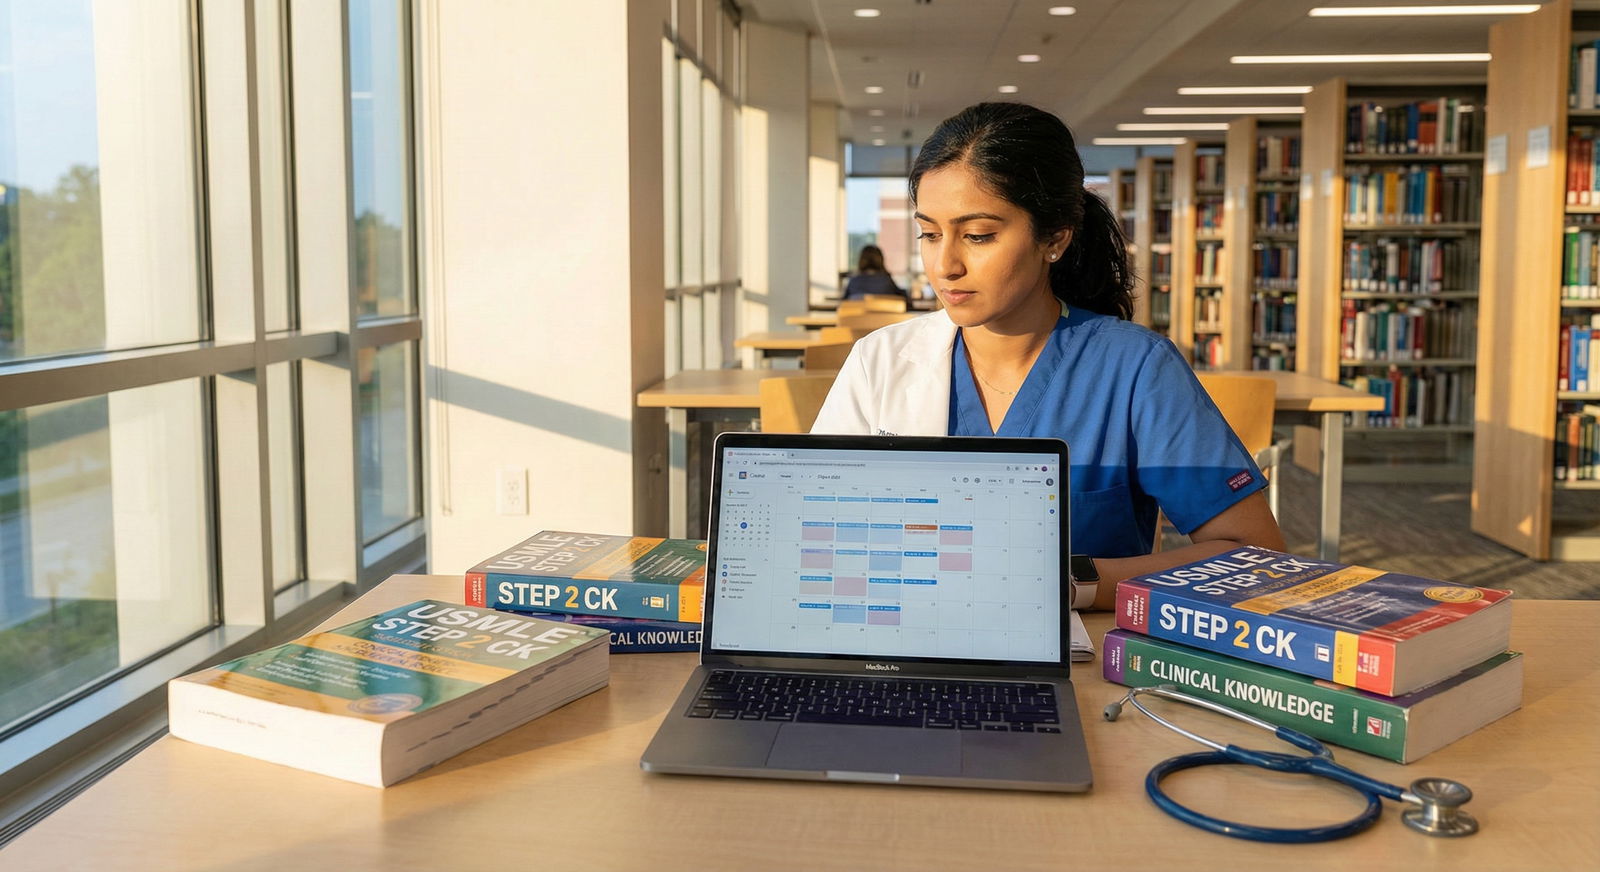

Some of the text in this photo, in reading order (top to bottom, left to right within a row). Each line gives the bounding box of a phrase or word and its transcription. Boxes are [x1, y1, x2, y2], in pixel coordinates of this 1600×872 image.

[486, 534, 575, 570] USMLE
[530, 551, 577, 572] STEP
[573, 535, 611, 547] CK
[1145, 551, 1276, 587] USMLE
[1192, 557, 1320, 596] STEP 2 CK
[498, 581, 560, 607] STEP
[565, 585, 579, 608] 2
[584, 586, 618, 611] CK
[372, 617, 468, 642] STEP
[456, 634, 493, 649] 2
[486, 640, 550, 660] CK
[407, 603, 580, 645] USMLE
[637, 630, 703, 645] KNOWLED
[1159, 603, 1229, 641] STEP
[1232, 620, 1250, 649] 2
[1255, 625, 1297, 661] CK
[1150, 659, 1220, 694] CLINICAL
[1225, 679, 1335, 724] KNOWLEDGE
